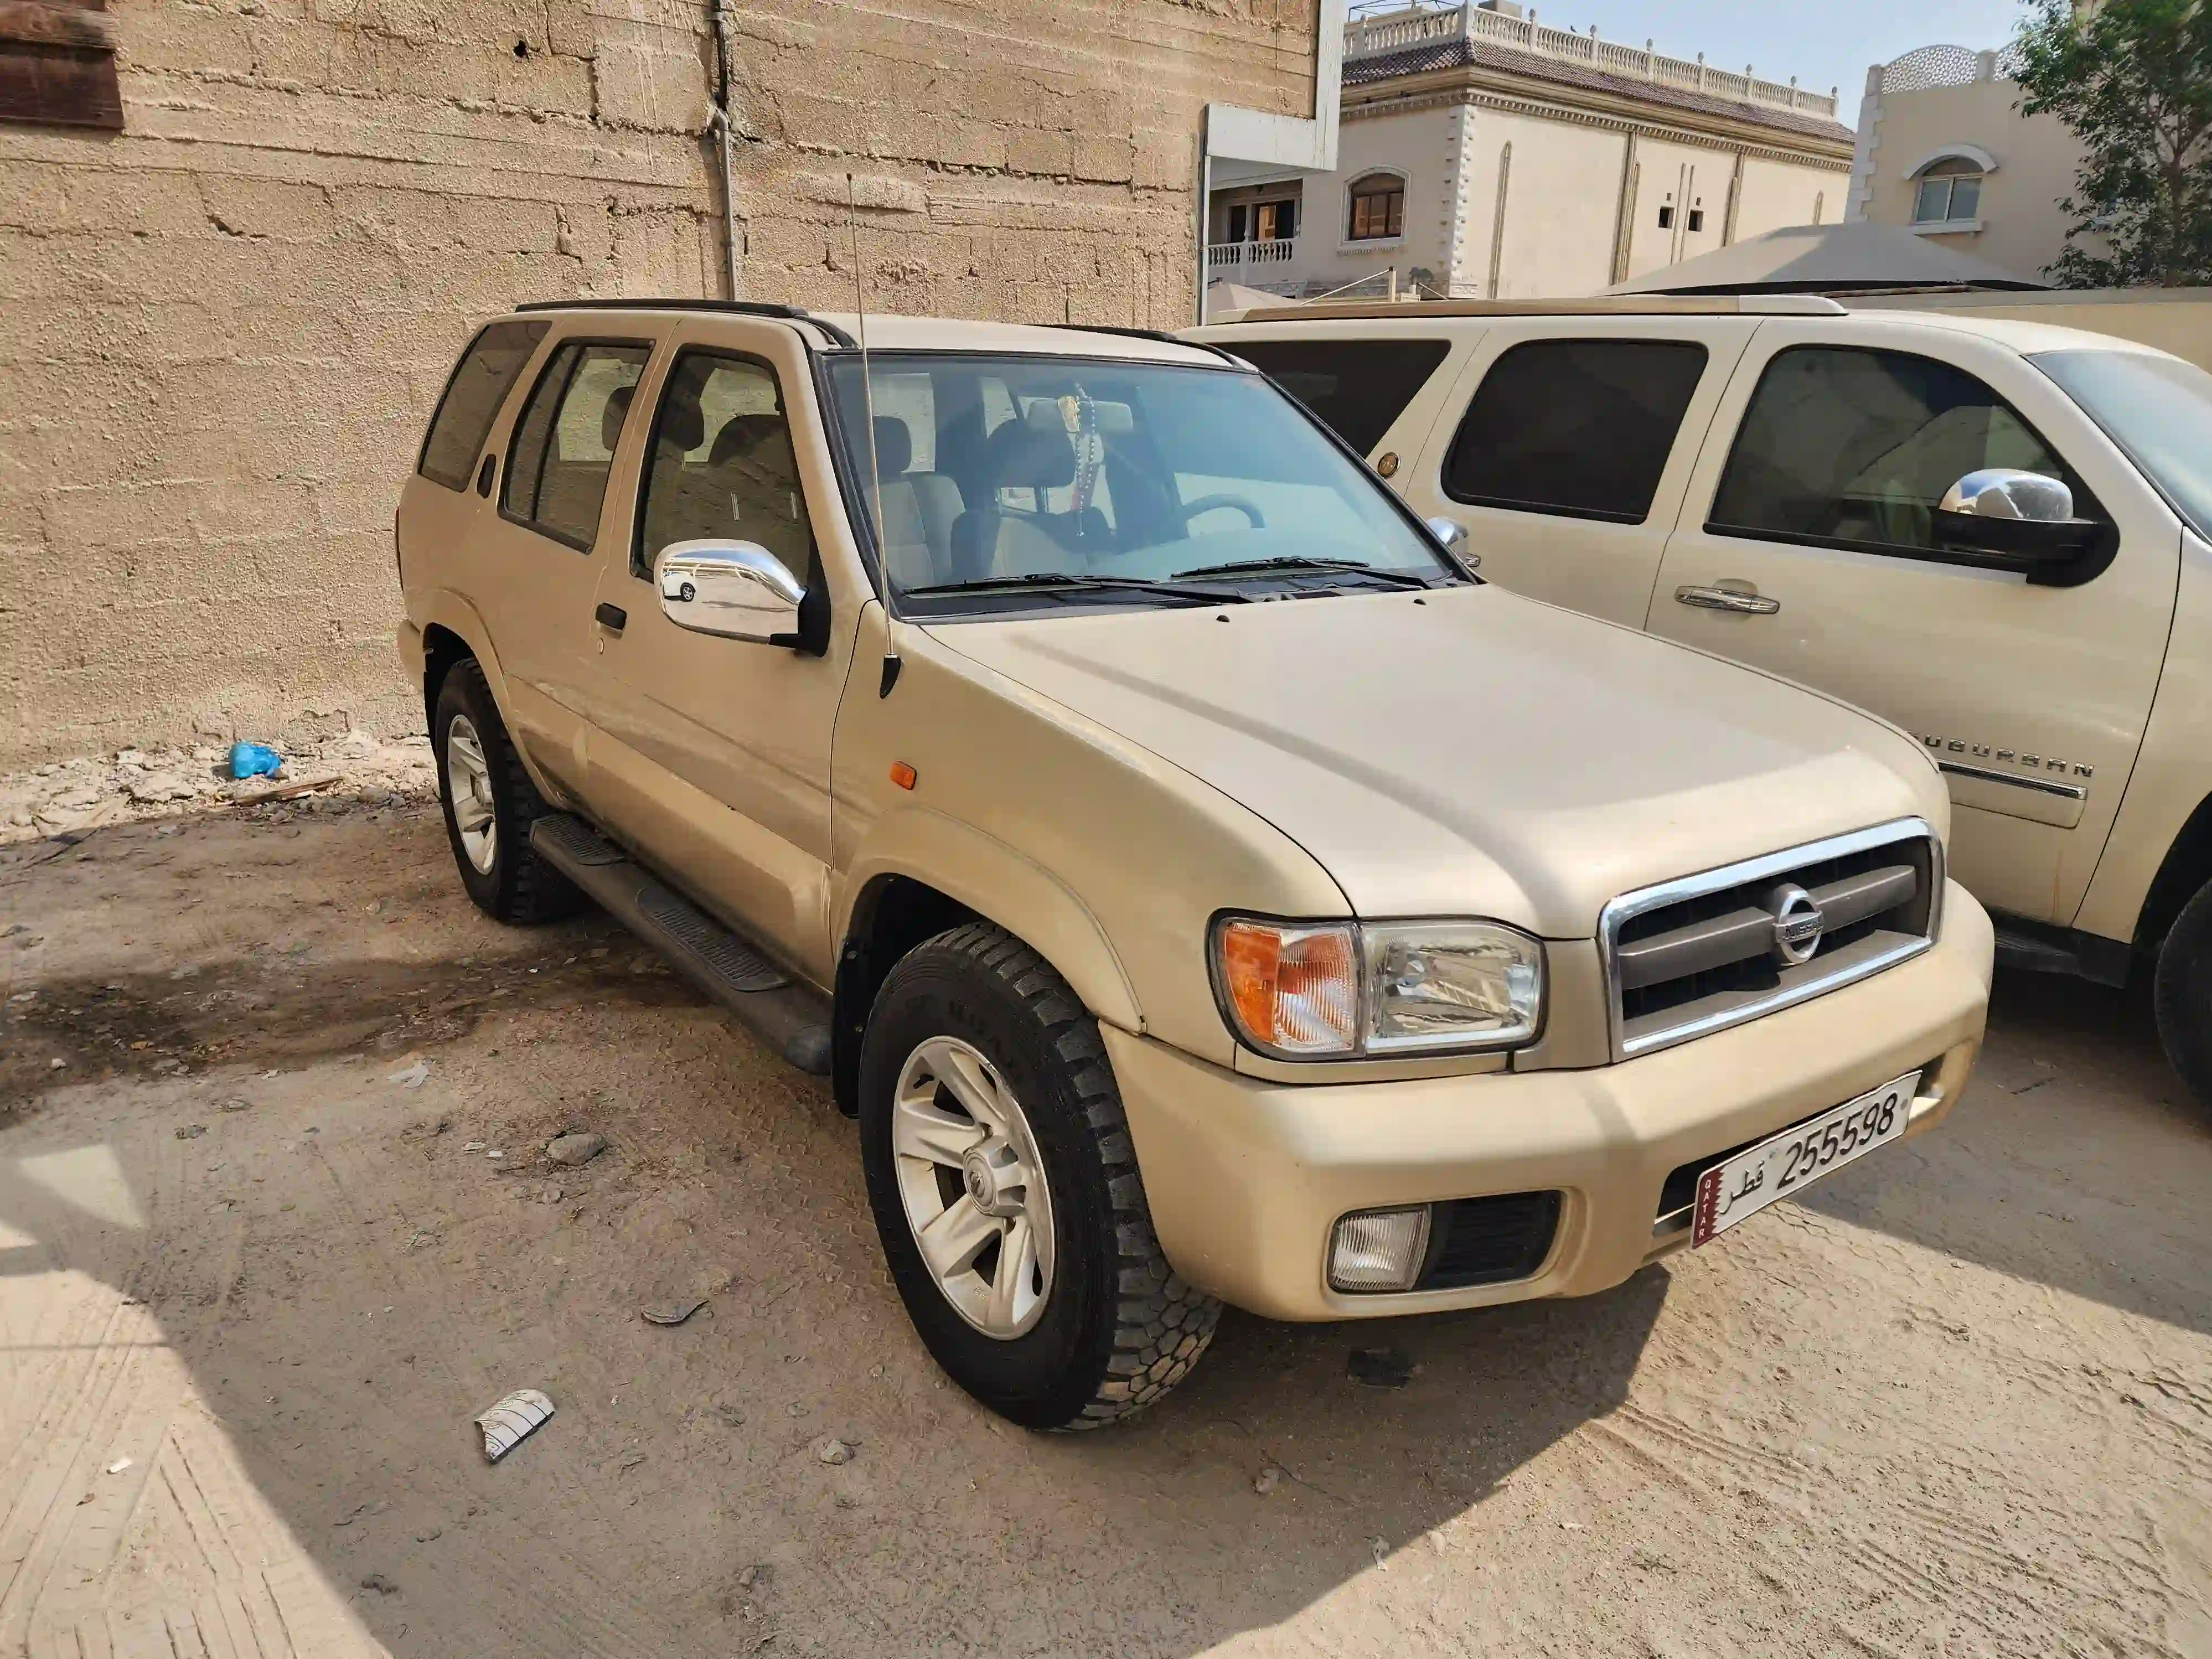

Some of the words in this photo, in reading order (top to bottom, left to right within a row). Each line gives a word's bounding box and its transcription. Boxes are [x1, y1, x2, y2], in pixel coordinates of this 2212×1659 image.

[1719, 1160, 1765, 1215] قطر
[1776, 1092, 1899, 1190] 255598
[1698, 1179, 1712, 1239] QATAR
